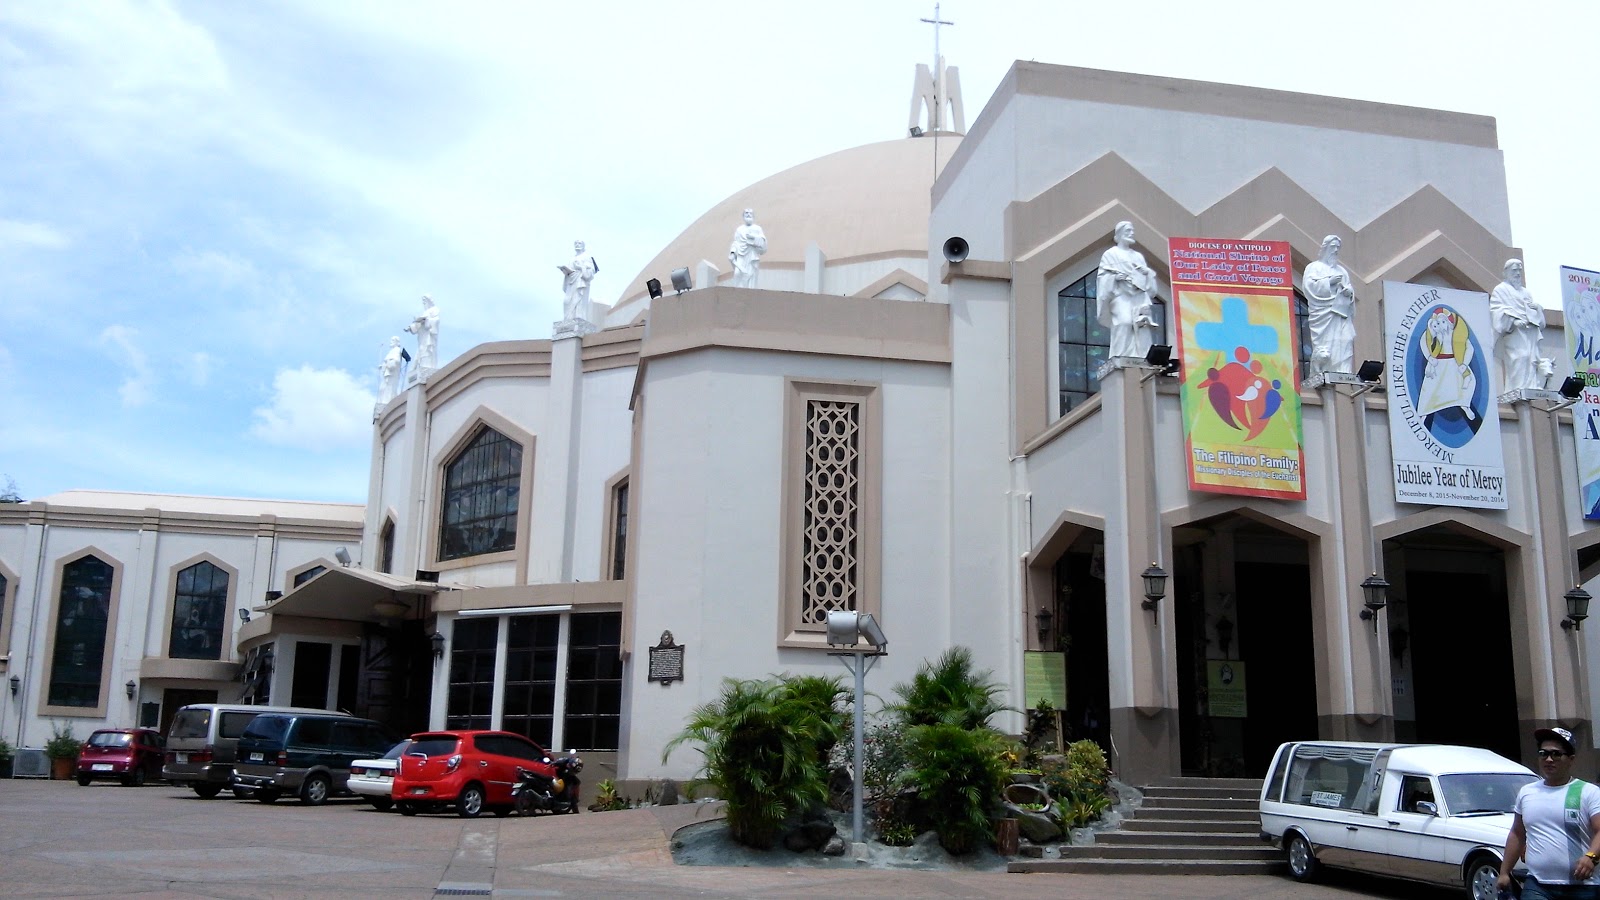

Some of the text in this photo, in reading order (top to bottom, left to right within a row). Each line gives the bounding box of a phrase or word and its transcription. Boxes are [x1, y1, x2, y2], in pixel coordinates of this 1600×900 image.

[1173, 249, 1285, 262] National Shrine of
[1173, 260, 1286, 273] Our Lady of Peace
[1178, 272, 1284, 285] and Good Voyage
[1568, 274, 1591, 285] 2016
[1392, 289, 1455, 464] MERCIFUL LIKE THE FATHER
[1194, 449, 1298, 471] The Filipino Family:
[1196, 466, 1225, 476] Missionary
[1228, 469, 1253, 477] Disciples
[1261, 471, 1271, 479] the
[1272, 473, 1298, 481] Eucharist
[1397, 464, 1502, 495] Jubilee Year of Mercy
[1399, 490, 1427, 498] December
[1435, 492, 1479, 502] 2015-November
[1480, 495, 1490, 503] 20,
